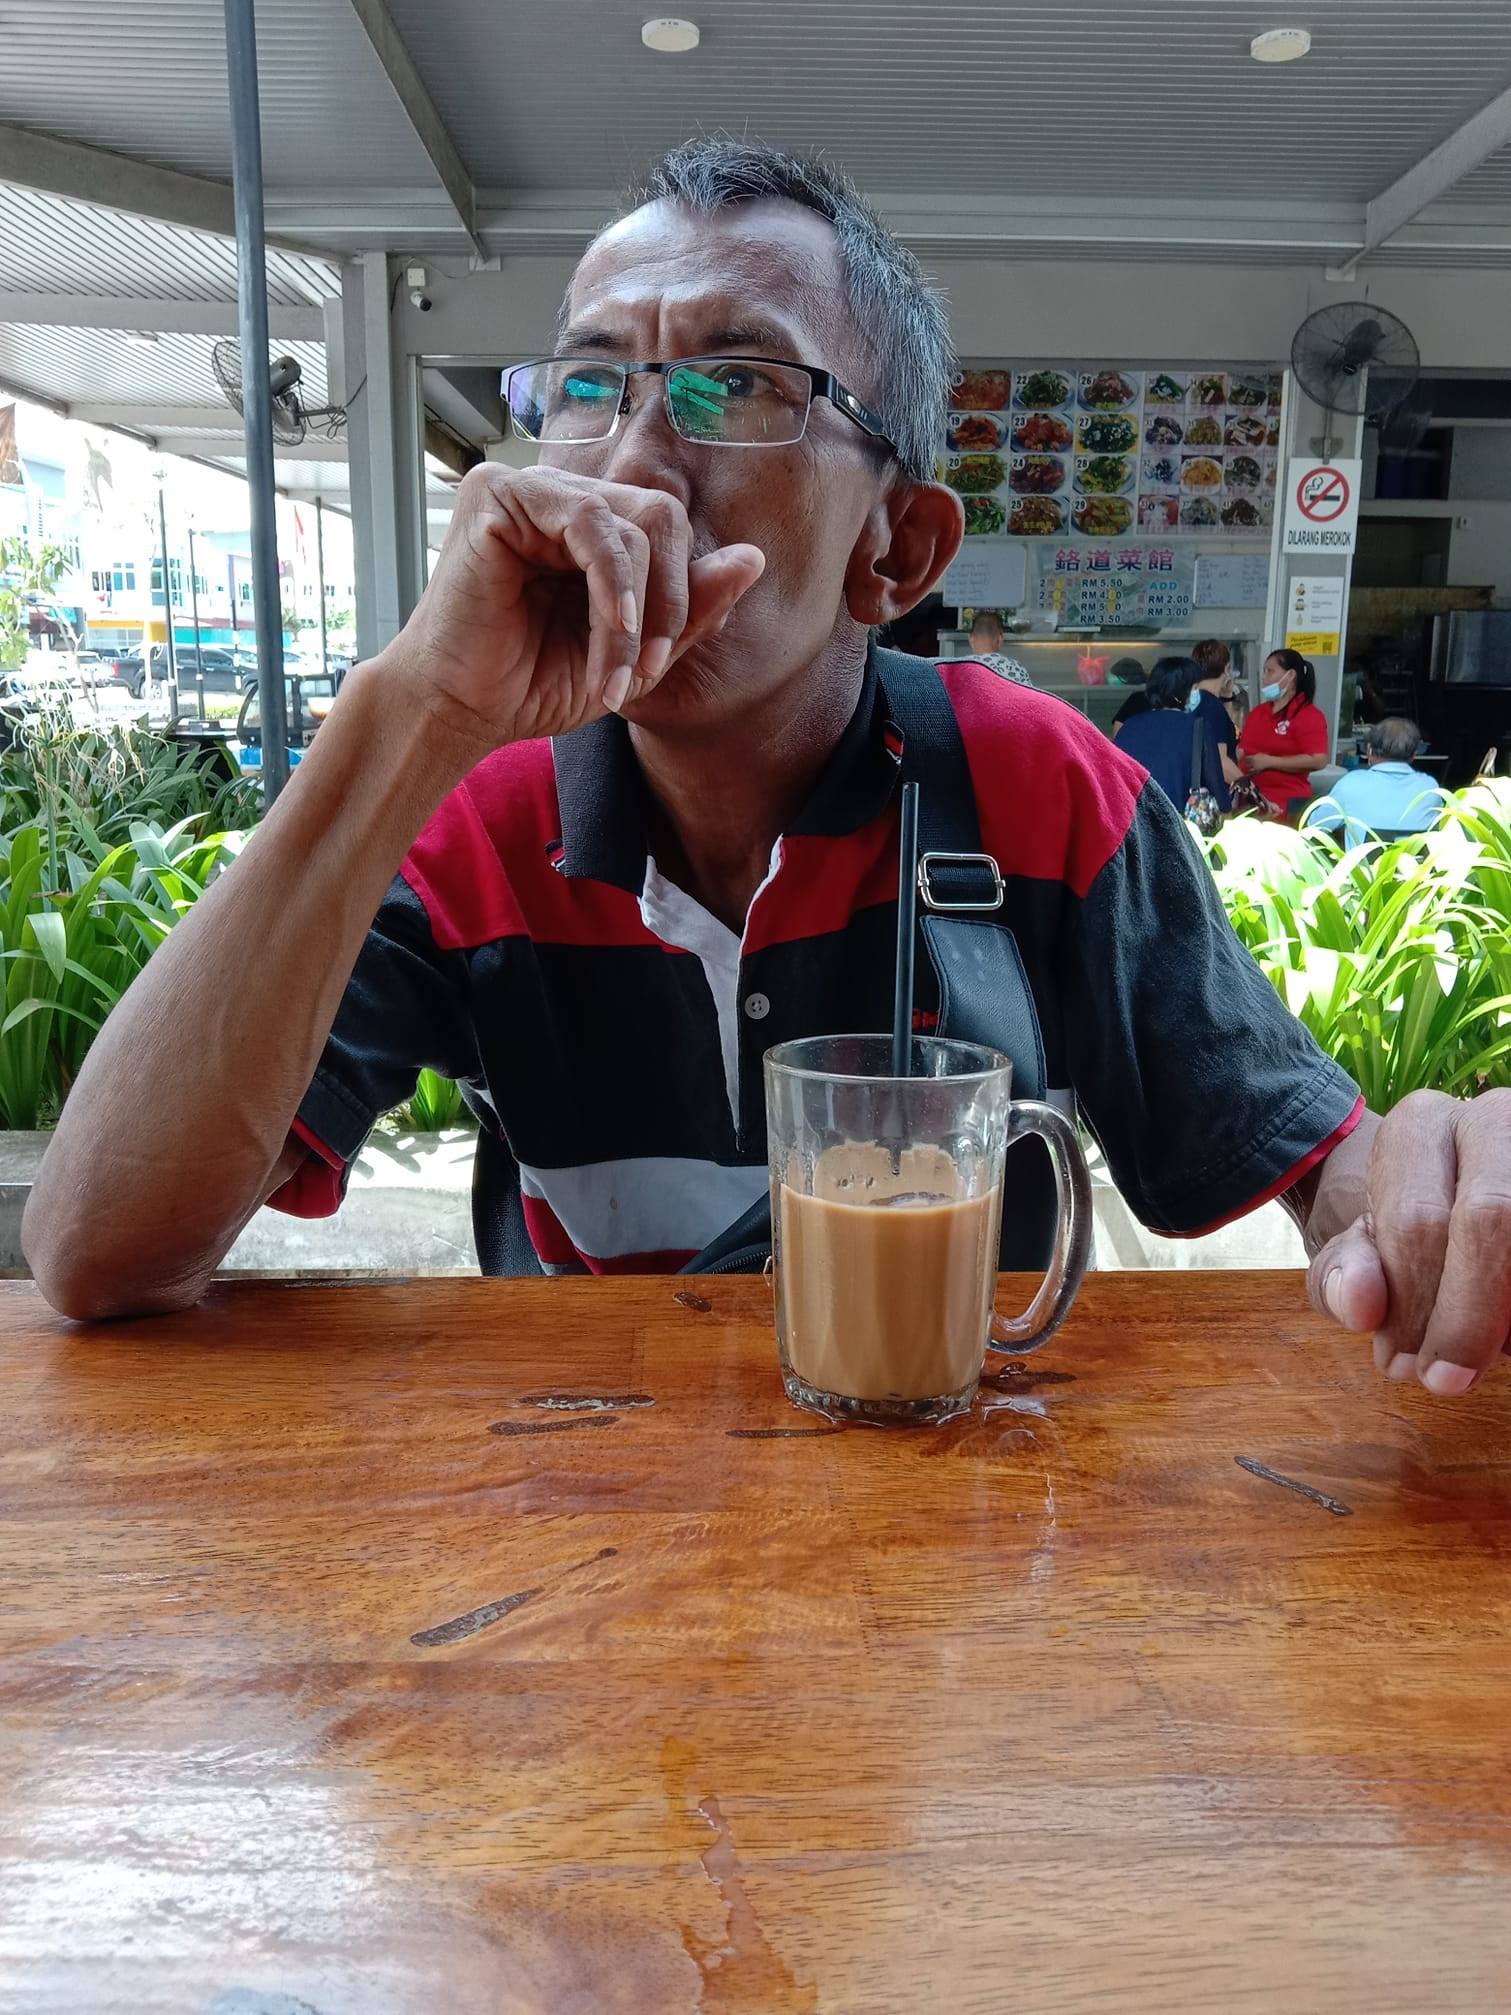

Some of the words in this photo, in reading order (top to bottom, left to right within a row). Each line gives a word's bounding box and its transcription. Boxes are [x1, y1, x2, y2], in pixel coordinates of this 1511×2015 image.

[1016, 375, 1028, 384] 22
[951, 416, 960, 425] 19
[1014, 417, 1025, 426] 23
[1079, 418, 1090, 427] 27
[949, 457, 959, 466] 20
[1013, 458, 1023, 467] 24
[1075, 500, 1086, 509] 29
[1287, 530, 1319, 545] DILARANG
[1321, 530, 1351, 546] MEROKOK
[1082, 578, 1097, 587] RM
[1100, 578, 1122, 587] 5.50
[1150, 582, 1178, 590] ADD
[1081, 591, 1096, 599] RM
[1100, 590, 1121, 599] 4.0
[1148, 595, 1164, 604] RM
[1167, 595, 1189, 604] 2.00
[1081, 603, 1096, 611] RM
[1099, 603, 1121, 611] 5.0
[1148, 608, 1163, 616] RM
[1166, 608, 1189, 617] 3.00
[1080, 615, 1095, 623] RM
